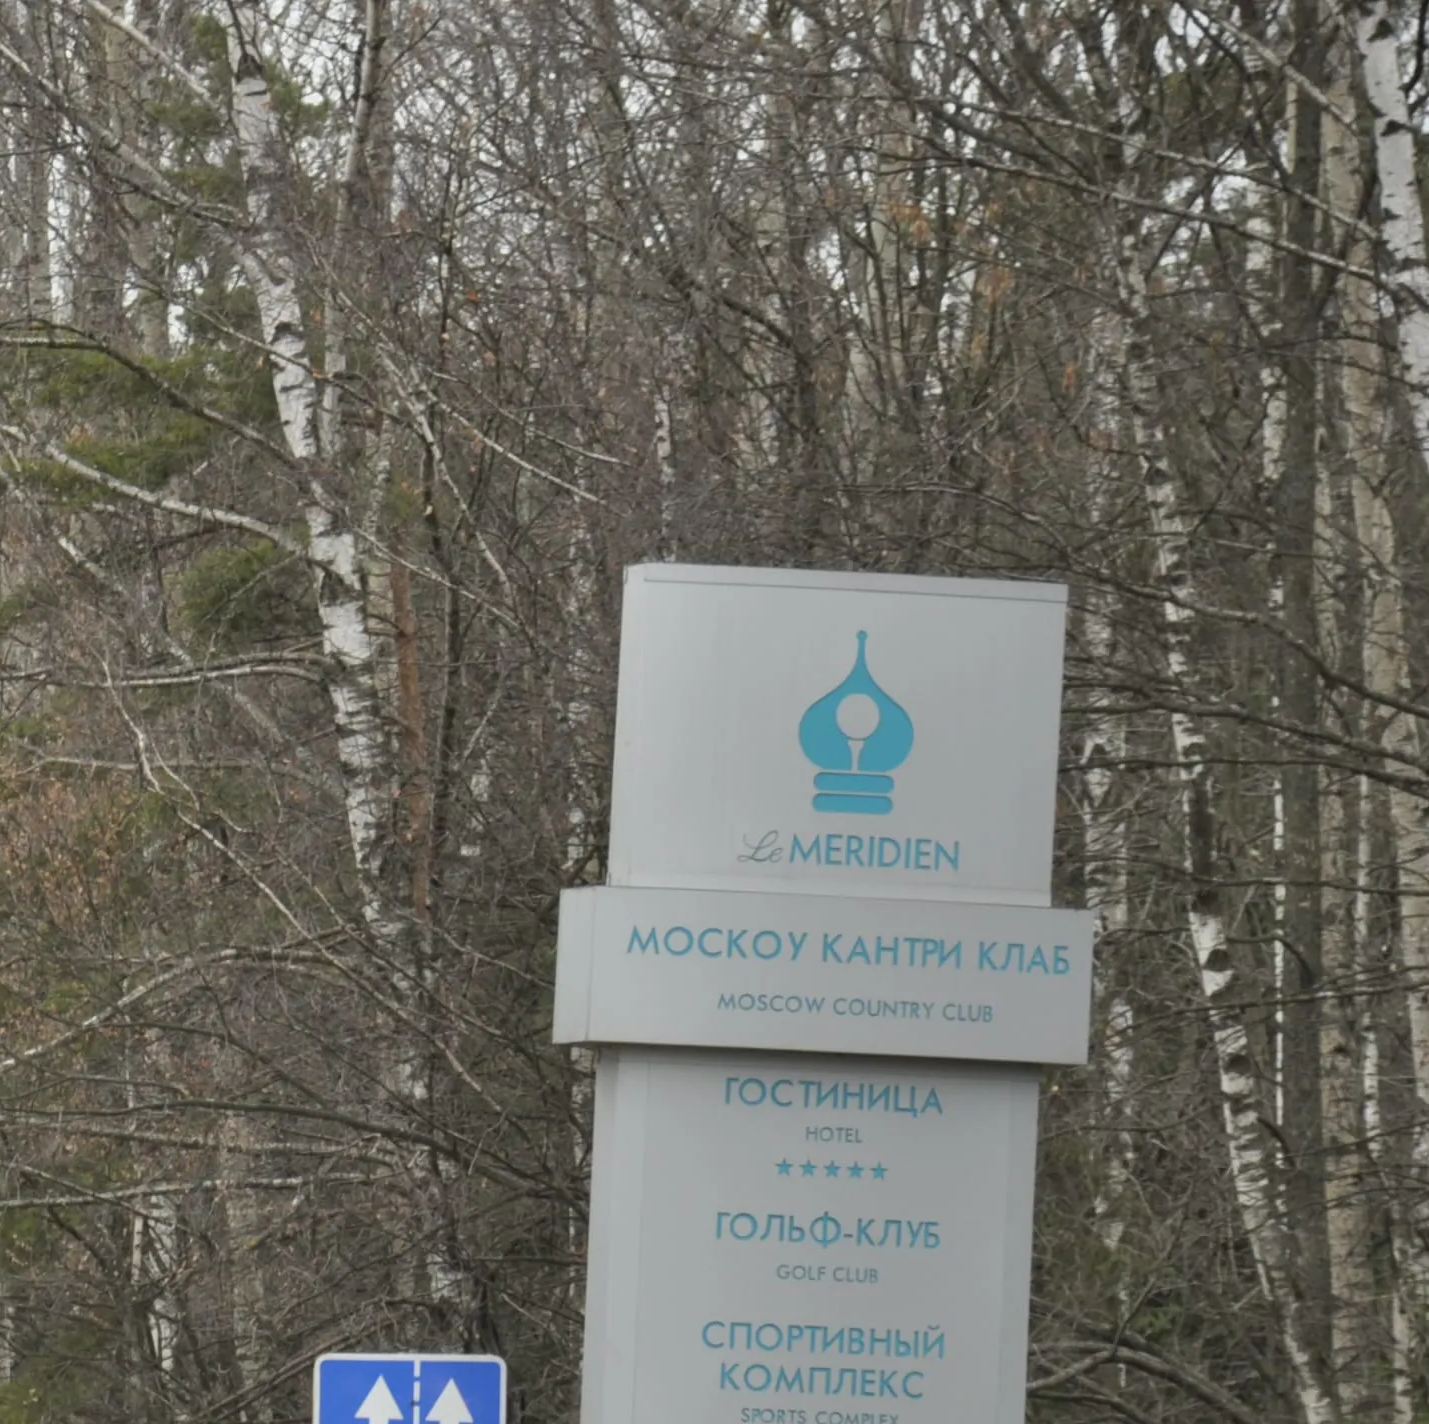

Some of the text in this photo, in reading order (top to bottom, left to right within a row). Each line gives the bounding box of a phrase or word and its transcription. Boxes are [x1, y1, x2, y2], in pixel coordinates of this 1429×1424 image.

[737, 830, 961, 871] Le MERIDIEN
[627, 925, 1071, 976] МОСКОУ КАНТРИ КЛАБ
[717, 993, 993, 1023] MOSCOW COUNTRY CLUB
[724, 1077, 944, 1118] ГОСТИНИЦА
[805, 1126, 863, 1144] HOTEL
[716, 1211, 941, 1249] ГОЛЬФ-КЛУБ
[776, 1265, 879, 1283] GOLF CLUB
[702, 1320, 945, 1360] СПОРТИВНЫЙ
[720, 1362, 924, 1400] КОМПЛЕКС
